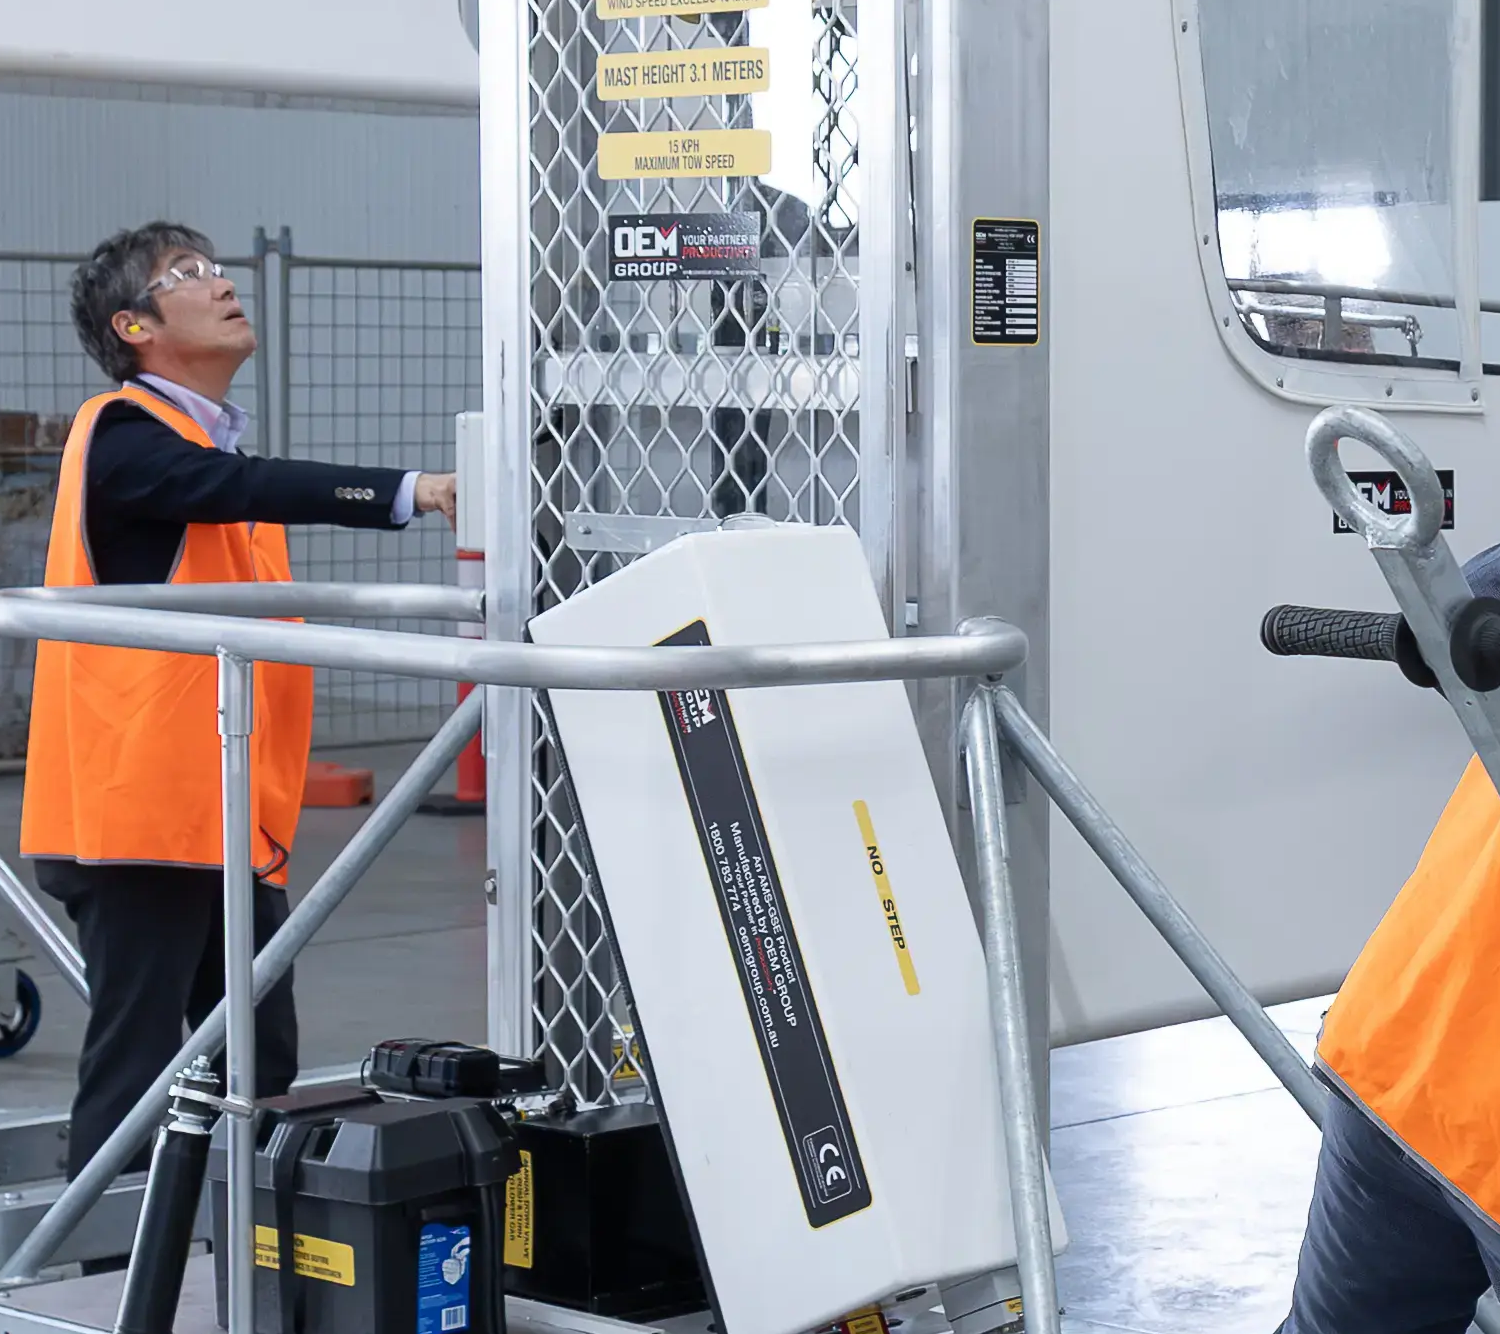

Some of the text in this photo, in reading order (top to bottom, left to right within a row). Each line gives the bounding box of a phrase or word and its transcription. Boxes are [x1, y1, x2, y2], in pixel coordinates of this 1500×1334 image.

[604, 59, 764, 87] MAST HEIGHT 3.1 METERS
[668, 139, 700, 153] 15 KPH
[635, 154, 735, 171] MAXIMUM TOW SPEED
[614, 226, 678, 258] OEM
[682, 235, 705, 246] YOUR
[708, 234, 747, 246] PARTNER
[614, 262, 678, 277] GROUP
[867, 846, 906, 949] NO STEP
[709, 822, 780, 1048] 1800 783 774 oemgroup.com.au
[730, 821, 797, 1027] Manufactured by OEM GROUP
[752, 856, 763, 873] An
[776, 936, 796, 984] Product
